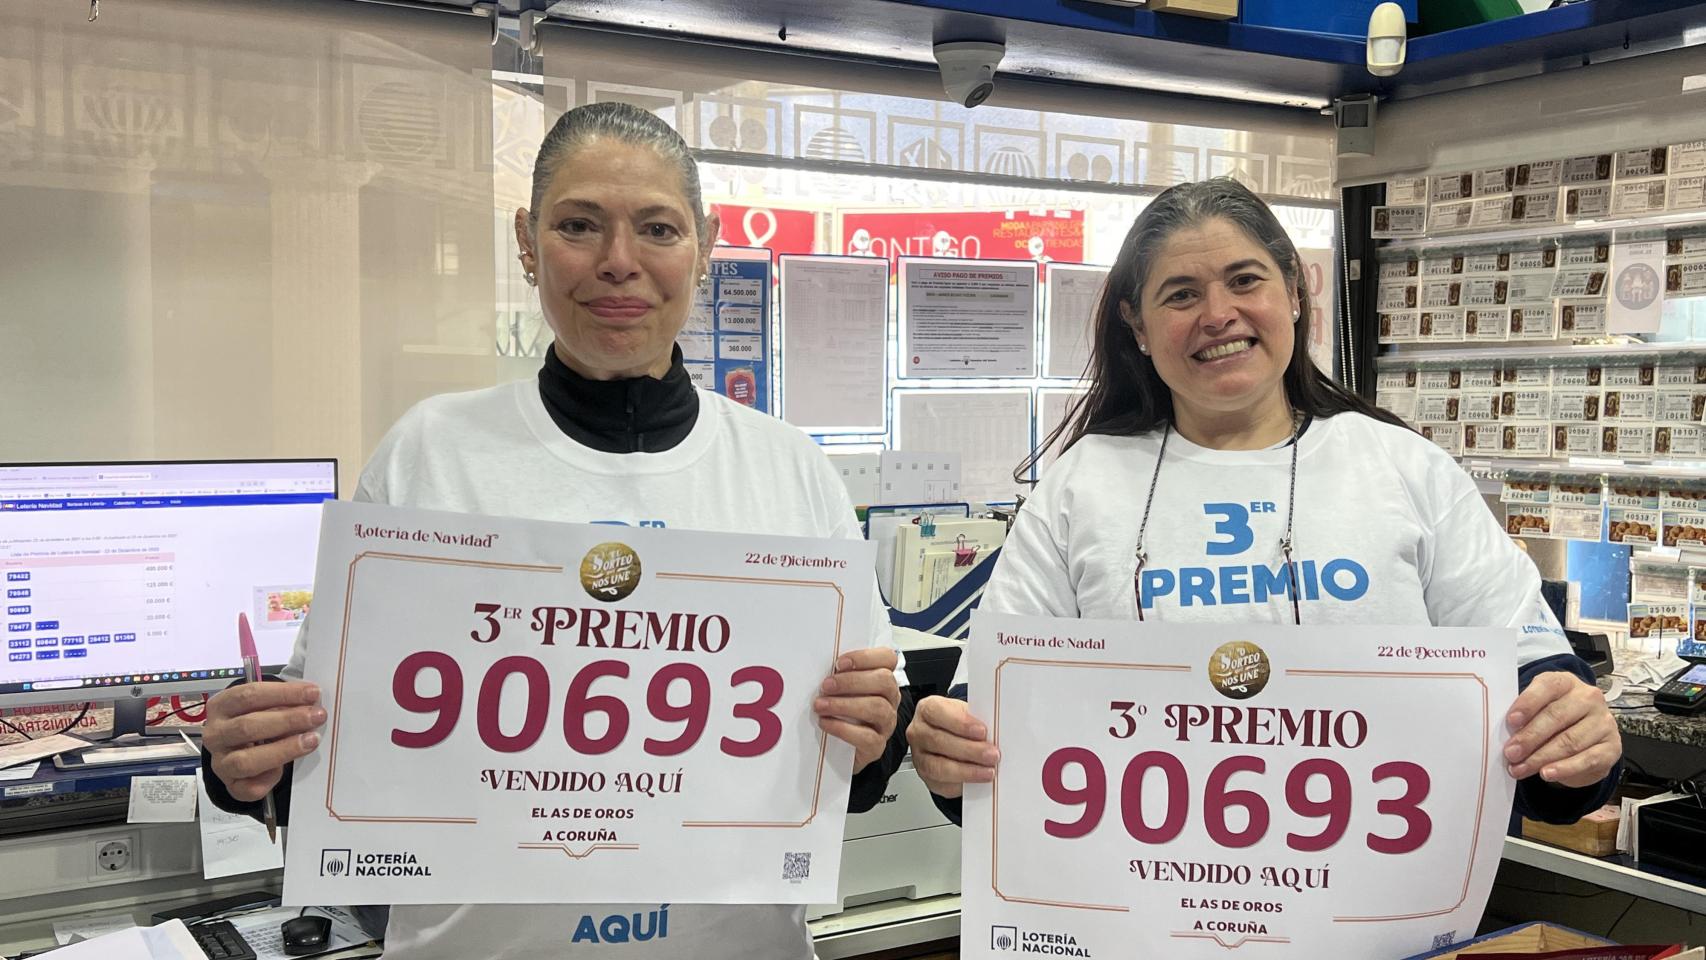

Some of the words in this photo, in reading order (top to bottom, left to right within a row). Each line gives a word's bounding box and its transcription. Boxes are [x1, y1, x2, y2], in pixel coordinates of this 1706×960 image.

[412, 530, 430, 542] de
[433, 531, 499, 548] Navidad
[745, 552, 760, 564] 22
[762, 553, 778, 565] de
[780, 554, 847, 569] Diciembre
[592, 577, 609, 590] NOS
[611, 571, 631, 584] UNE
[1141, 558, 1369, 609] PREMIO
[530, 607, 731, 654] PREMIO
[1048, 637, 1065, 648] de
[1067, 638, 1105, 650] Nadal
[1377, 646, 1394, 658] 22
[1396, 647, 1411, 658] de
[1414, 647, 1486, 660] Decembro
[1221, 676, 1239, 688] NOS
[1240, 669, 1260, 683] UNE
[391, 650, 785, 758] 90693
[1164, 703, 1368, 750] PREMIO
[481, 769, 606, 793] VENDIDO
[614, 767, 684, 798] AQUÍ
[1041, 746, 1433, 855] 90693
[531, 807, 548, 819] EL
[550, 807, 571, 819] AS
[573, 808, 592, 819] DE
[594, 808, 634, 819] OROS
[542, 830, 554, 842] A
[557, 828, 617, 842] CORUÑA
[356, 852, 417, 865] LOTERÍA
[355, 865, 431, 877] NACIONAL
[1129, 859, 1252, 885] VENDIDO
[1260, 863, 1330, 892] AQUÍ
[1181, 897, 1197, 909] EL
[1199, 898, 1217, 910] AS
[1220, 899, 1241, 911] DE
[1243, 901, 1283, 913] OROS
[571, 904, 669, 944] AQUÍ
[1193, 920, 1204, 931] A
[1205, 920, 1268, 935] CORUÑA
[1022, 930, 1077, 946] LOTERÍA
[1022, 943, 1091, 958] NACIONAL
